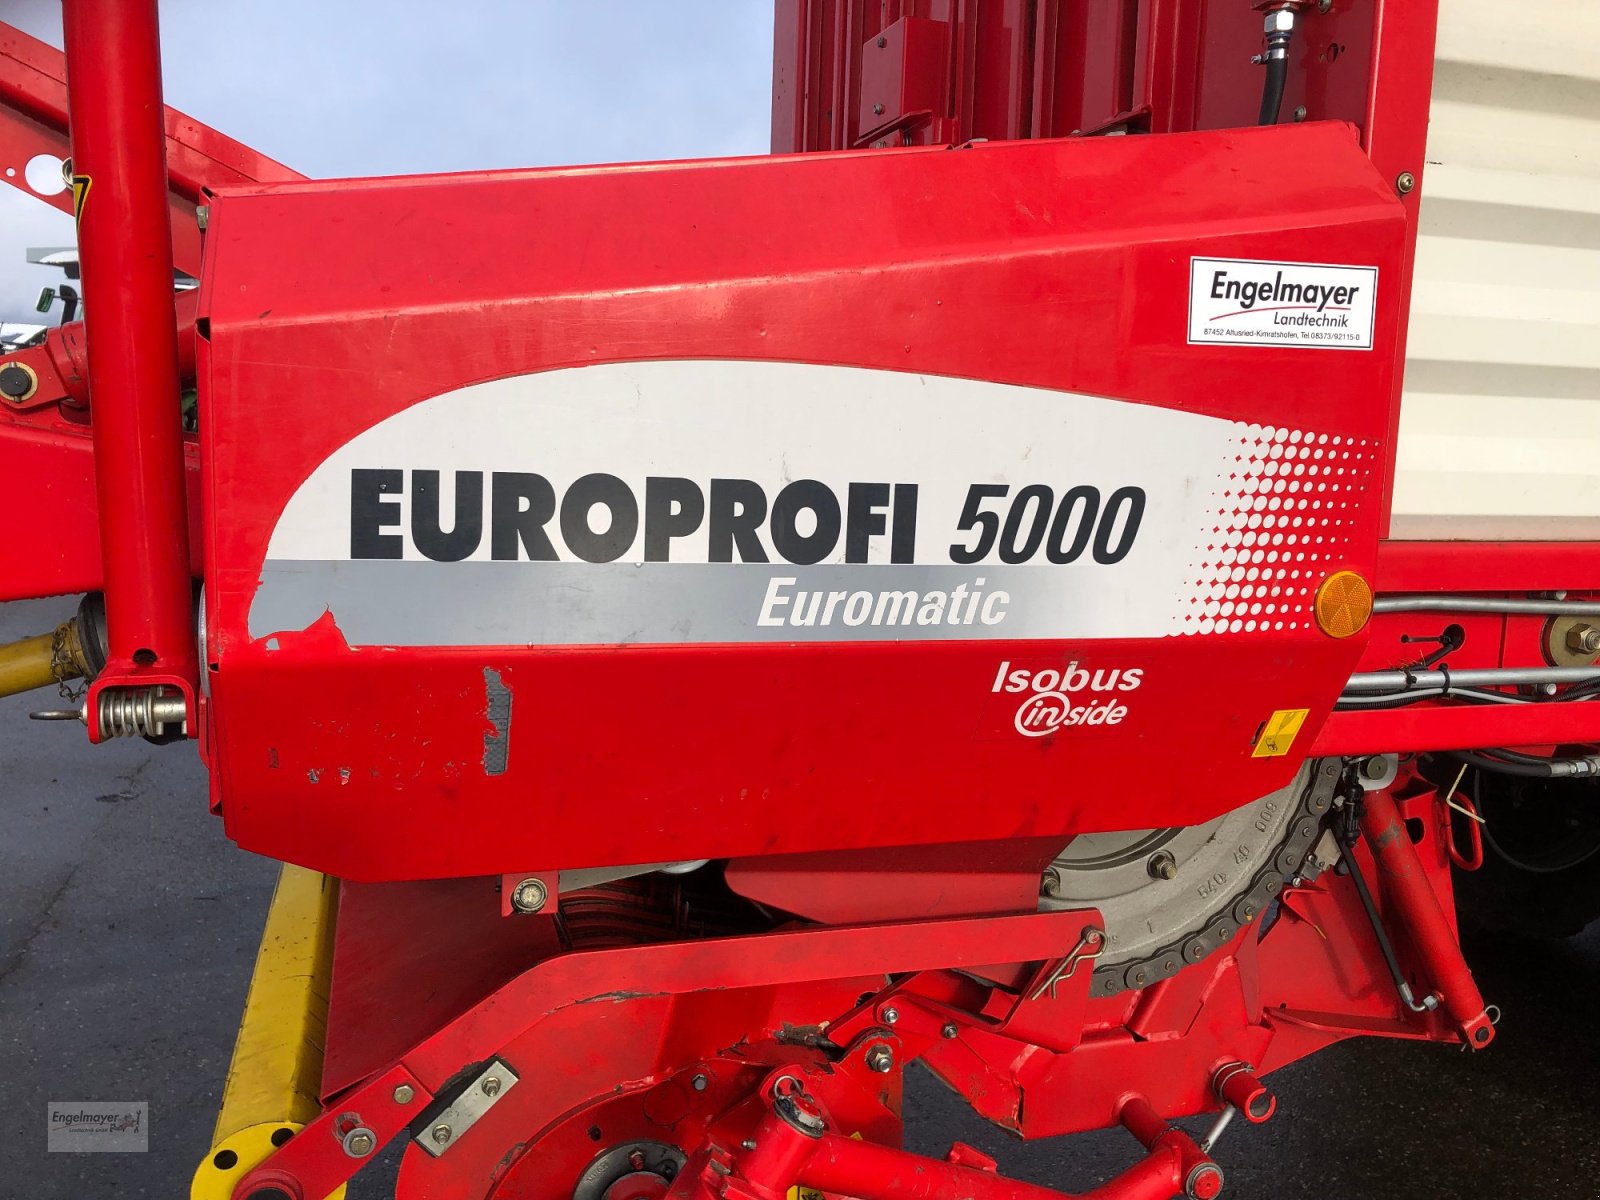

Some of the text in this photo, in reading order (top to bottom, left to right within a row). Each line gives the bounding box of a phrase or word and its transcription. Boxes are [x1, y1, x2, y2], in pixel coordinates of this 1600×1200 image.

[1210, 270, 1360, 312] Engelmayer
[1203, 328, 1224, 336] 87452
[1273, 312, 1349, 328] Landtechnik
[350, 468, 1147, 565] EUROPROFI 5000
[756, 576, 1011, 627] Euromatic
[991, 661, 1144, 693] Isobus
